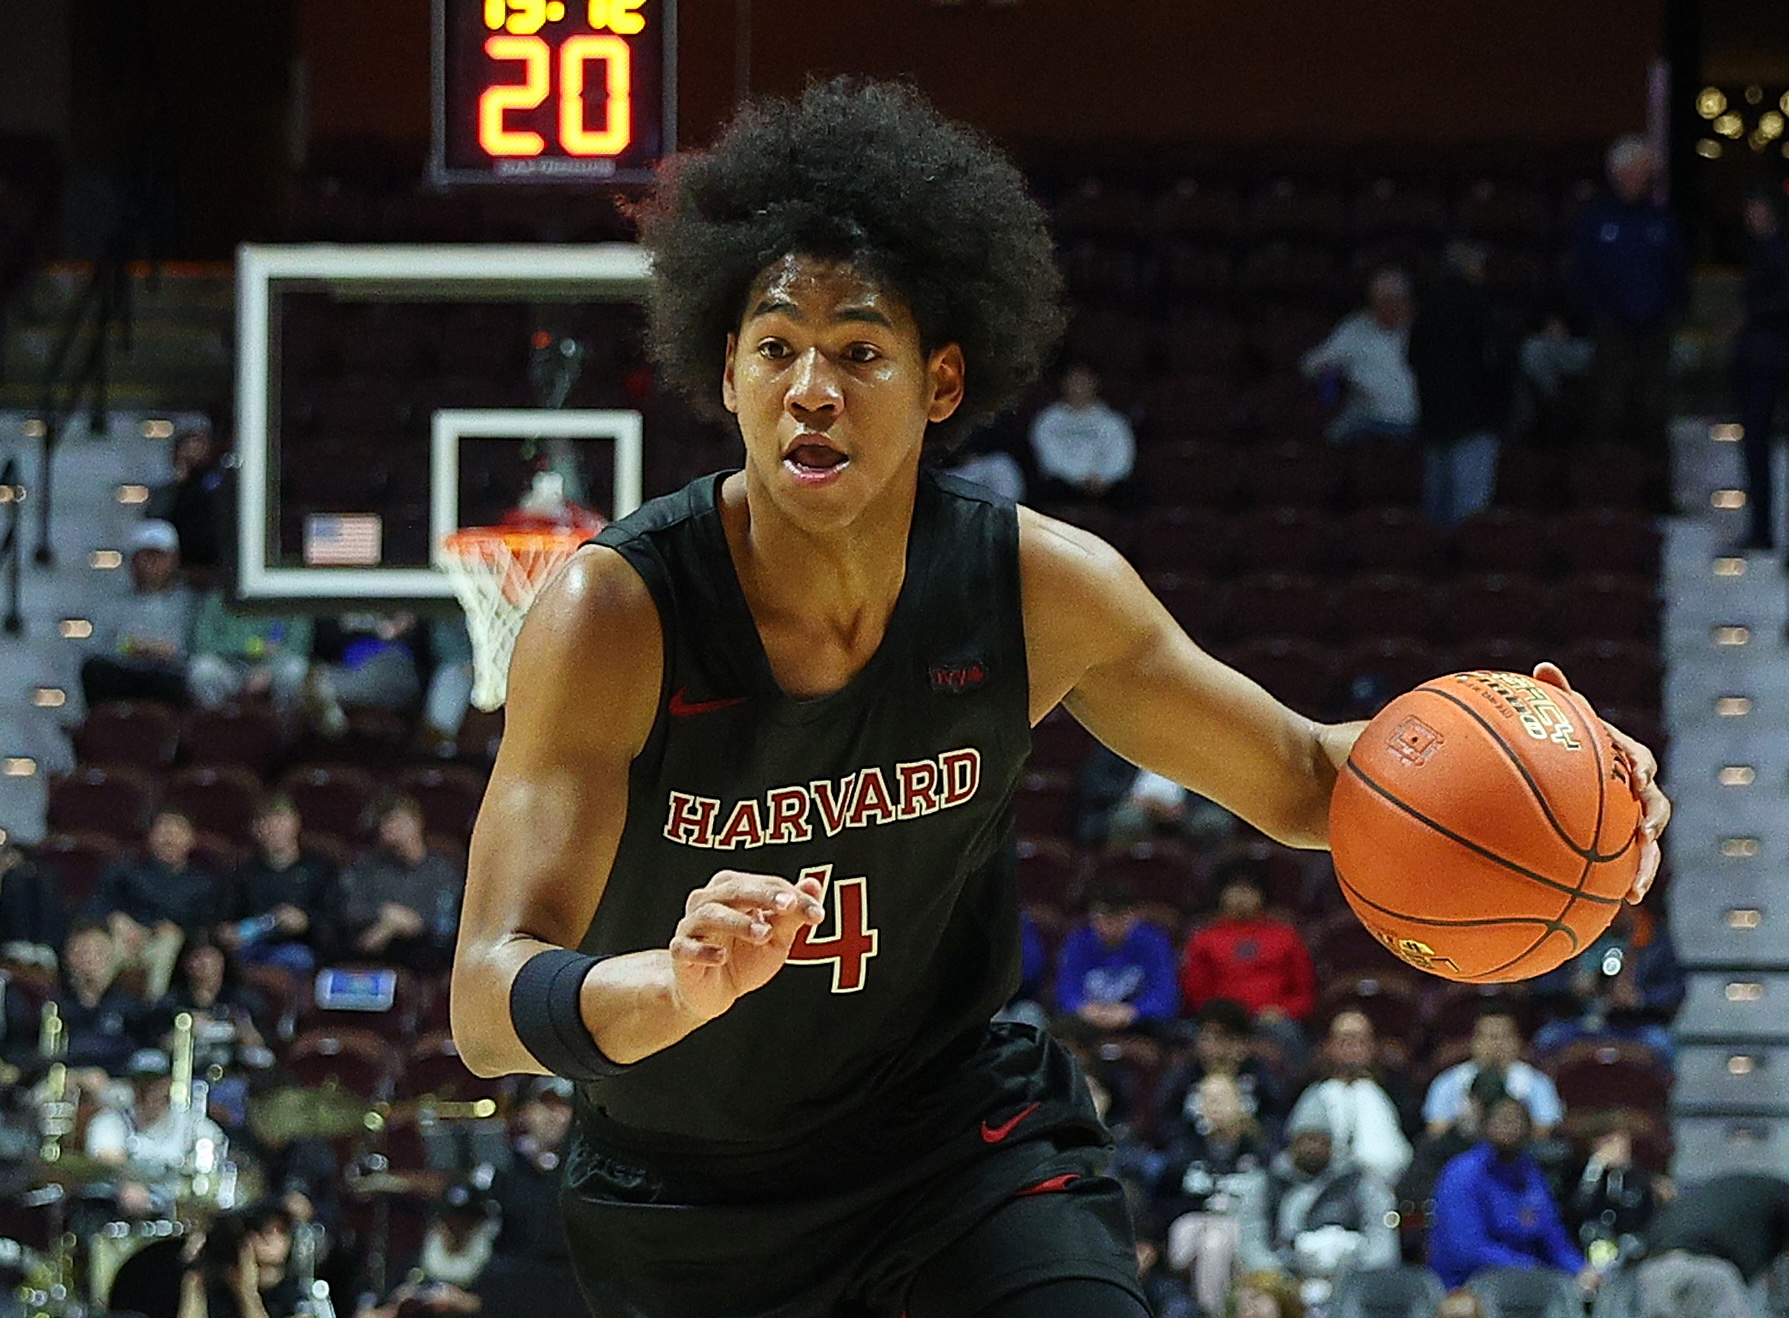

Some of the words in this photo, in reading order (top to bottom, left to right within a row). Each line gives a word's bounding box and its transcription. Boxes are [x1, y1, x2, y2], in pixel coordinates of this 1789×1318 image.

[479, 34, 632, 157] 20
[663, 747, 981, 850] HARVARD
[785, 863, 879, 994] 4
